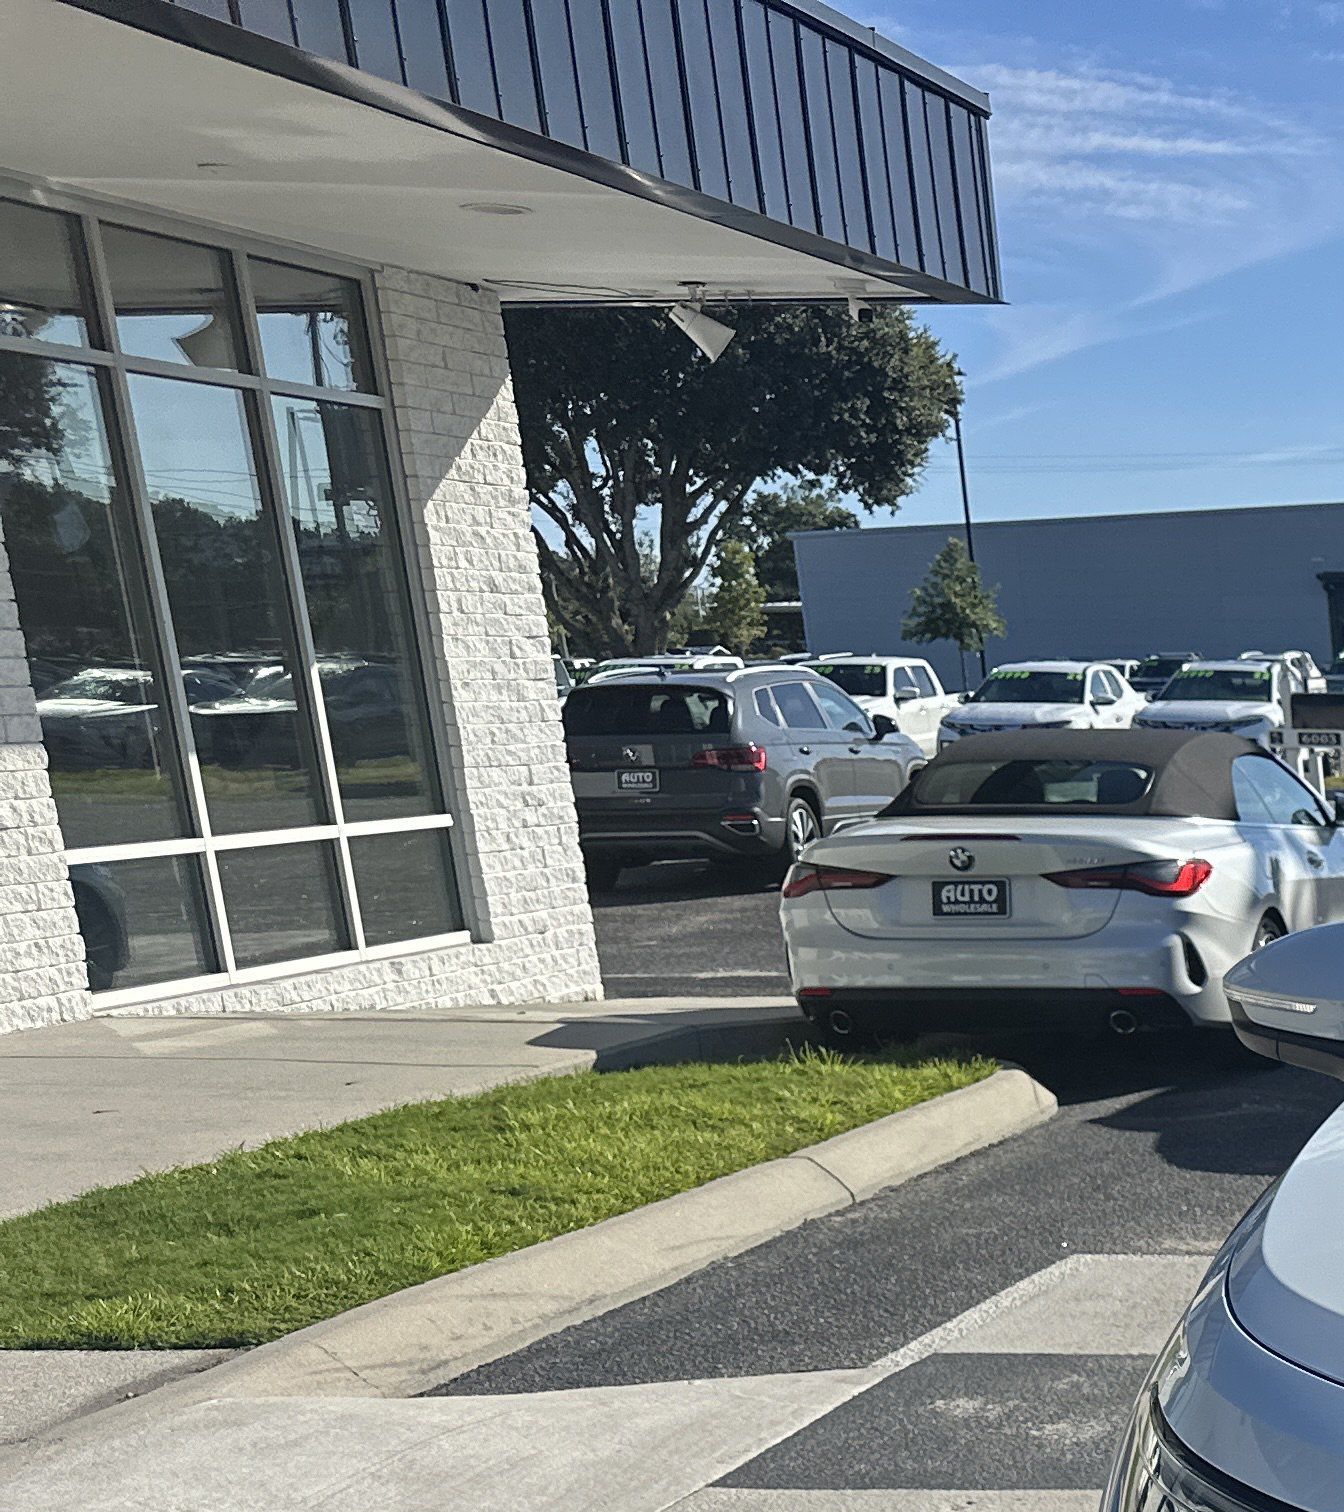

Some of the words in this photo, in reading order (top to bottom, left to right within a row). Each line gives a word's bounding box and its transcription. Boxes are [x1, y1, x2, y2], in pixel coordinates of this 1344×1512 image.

[622, 772, 653, 784] AUTO
[941, 884, 998, 903] AUTO
[942, 903, 998, 913] WHOLESALE
